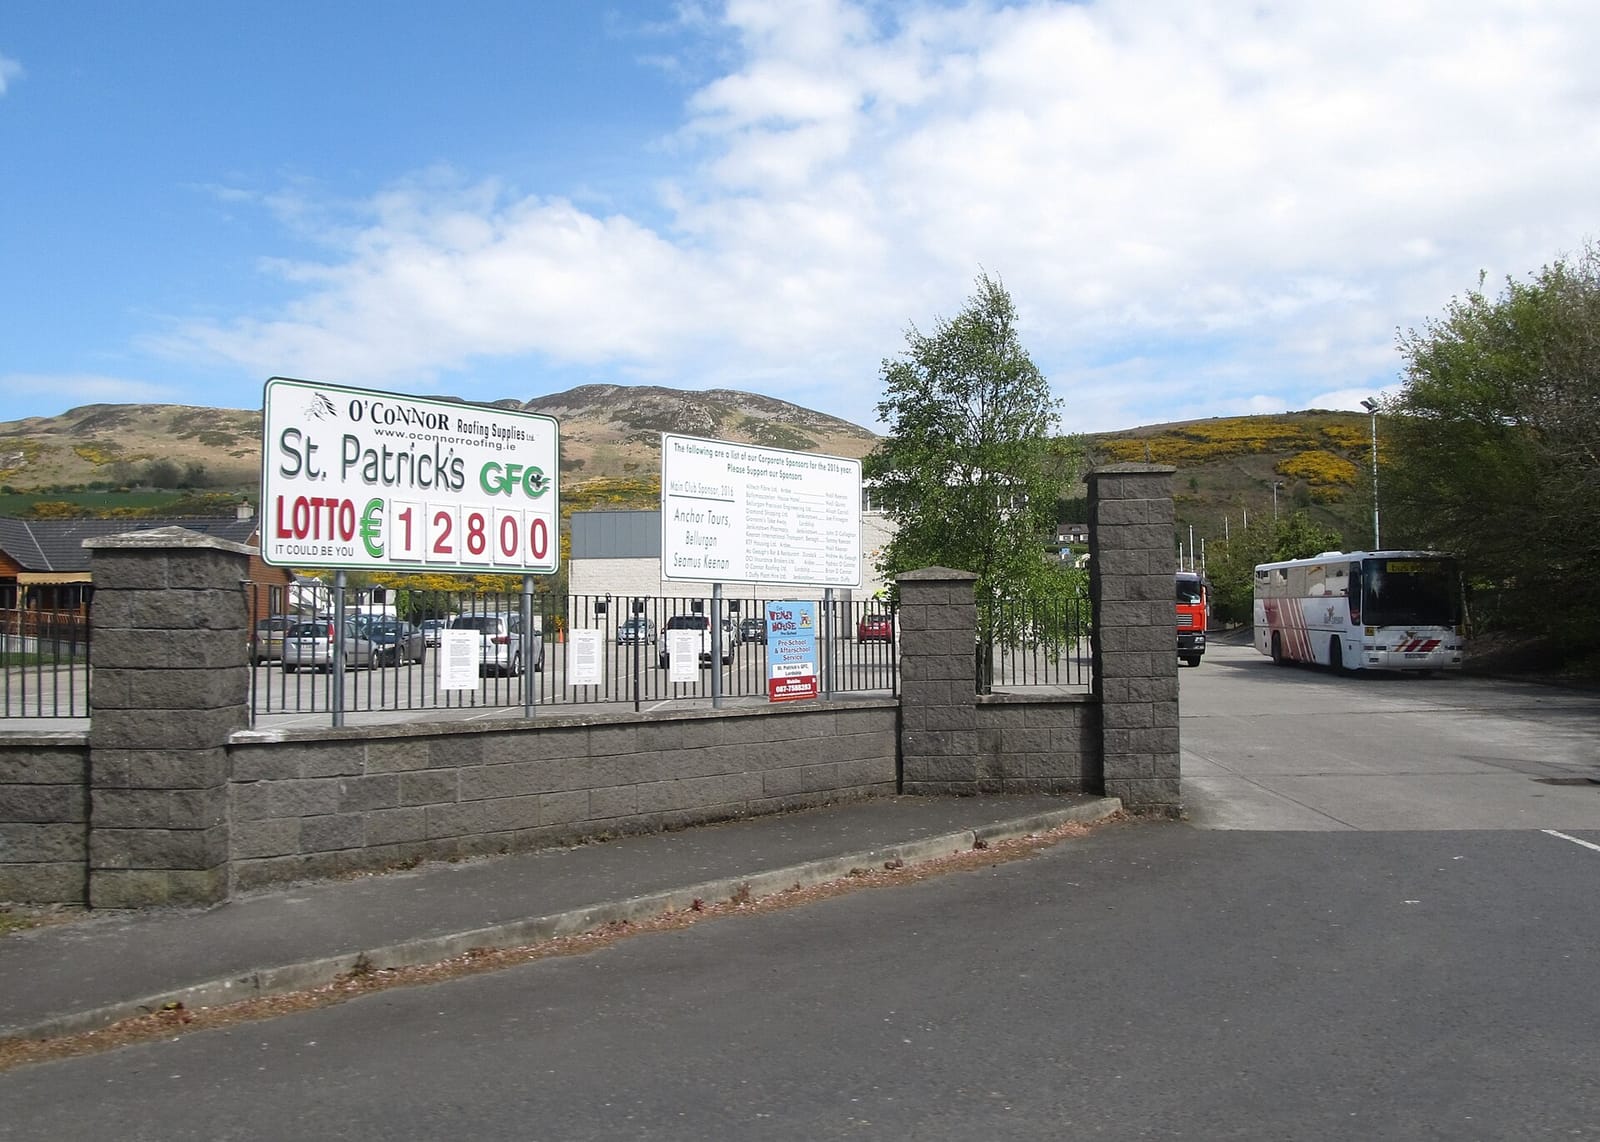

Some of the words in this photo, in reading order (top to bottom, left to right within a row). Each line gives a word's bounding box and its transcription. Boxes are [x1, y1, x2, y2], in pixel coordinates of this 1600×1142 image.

[374, 428, 516, 451] www.oconnorroofing.ie
[457, 418, 489, 439] Roofing
[492, 423, 526, 441] Supplies
[280, 428, 327, 481] St.
[340, 434, 465, 490] Patrick's
[479, 461, 551, 498] GFC
[674, 442, 684, 452] The
[686, 444, 713, 458] following
[714, 450, 724, 458] are
[731, 450, 740, 460] list
[741, 452, 747, 460] of
[758, 454, 784, 466] Corporate
[786, 457, 809, 468] Sponsors
[818, 462, 826, 471] the
[727, 463, 745, 474] Please
[747, 466, 768, 477] Support
[780, 470, 802, 480] Sponsors
[670, 480, 683, 491] Main
[685, 481, 696, 493] Club
[276, 495, 356, 542] LOTTO
[674, 508, 704, 523] Anchor
[708, 510, 730, 528] Tours,
[686, 530, 717, 550] Bellurgan
[275, 544, 284, 554] IT
[286, 545, 318, 556] COULD
[321, 546, 334, 556] BE
[335, 546, 354, 557] YOU
[674, 552, 702, 569] Seamus
[704, 554, 730, 569] Keenan
